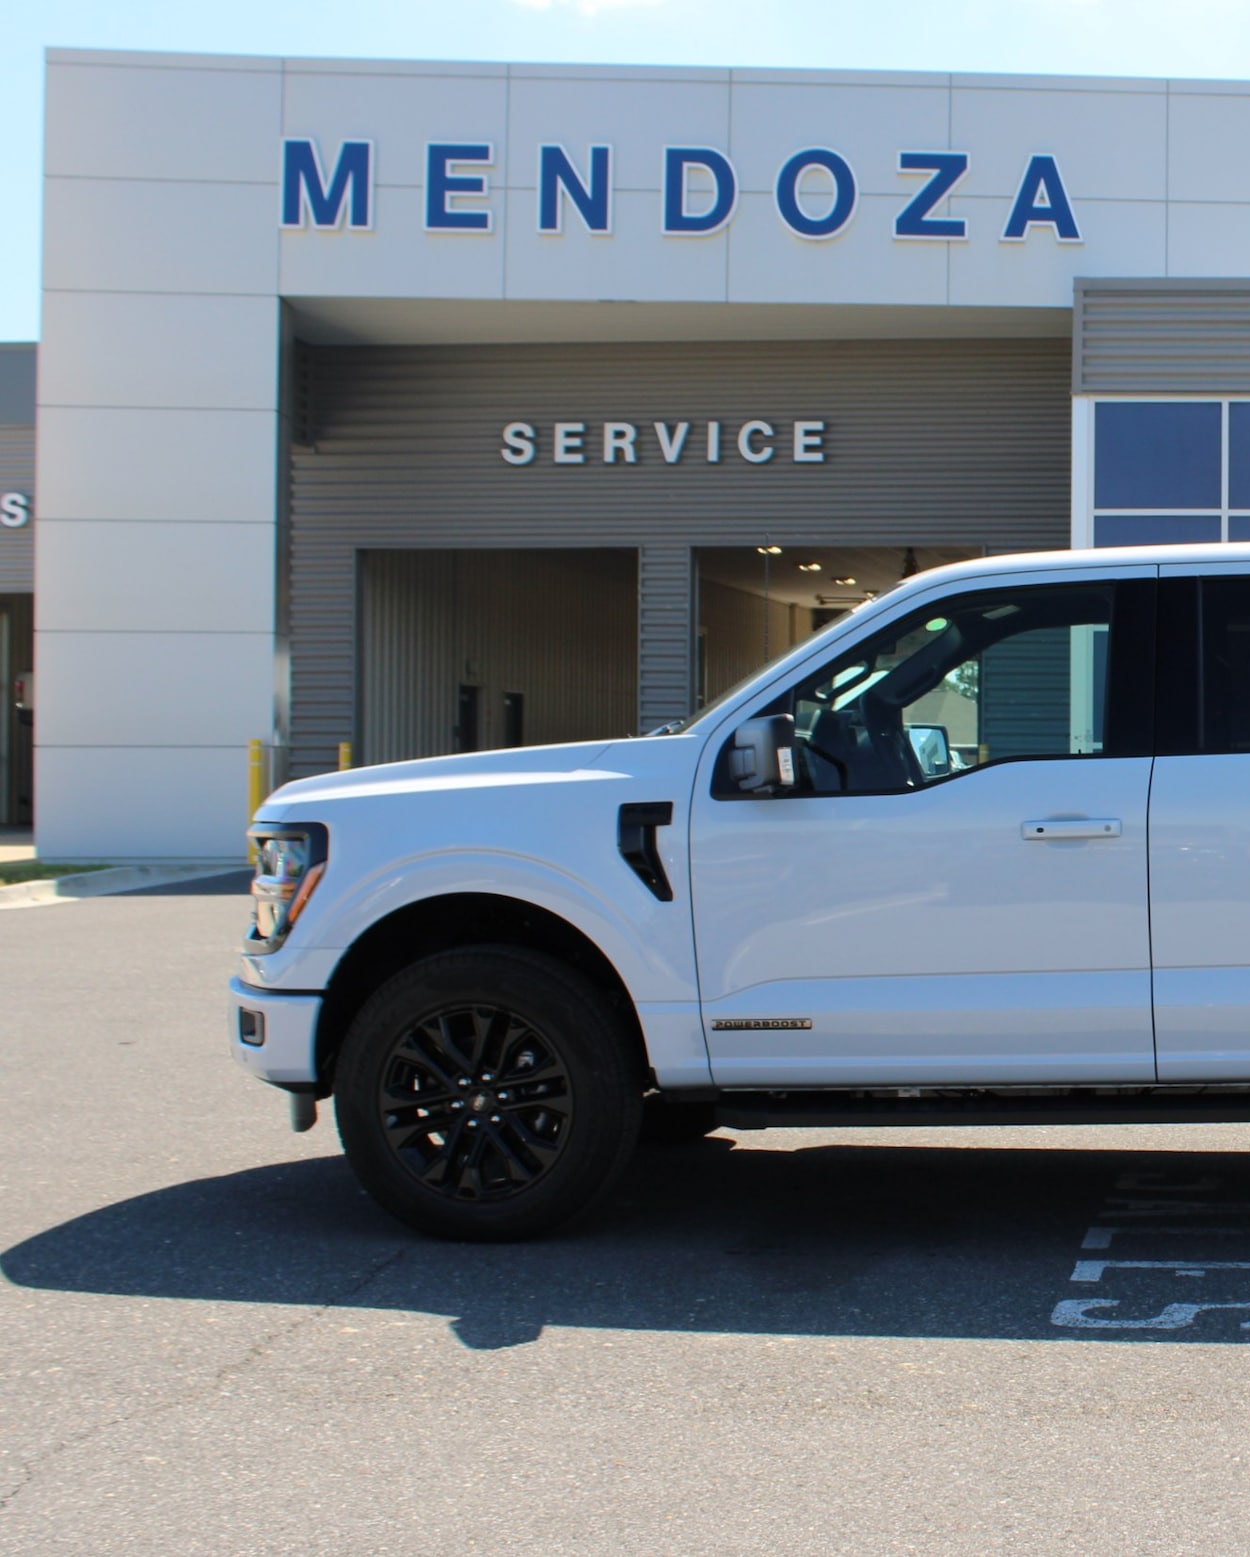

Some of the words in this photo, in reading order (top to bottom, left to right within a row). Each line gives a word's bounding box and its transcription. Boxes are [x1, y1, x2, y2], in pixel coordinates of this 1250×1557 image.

[281, 138, 1083, 243] MENDOZA
[501, 420, 825, 465] SERVICE
[714, 1020, 808, 1029] POWERBOOST
